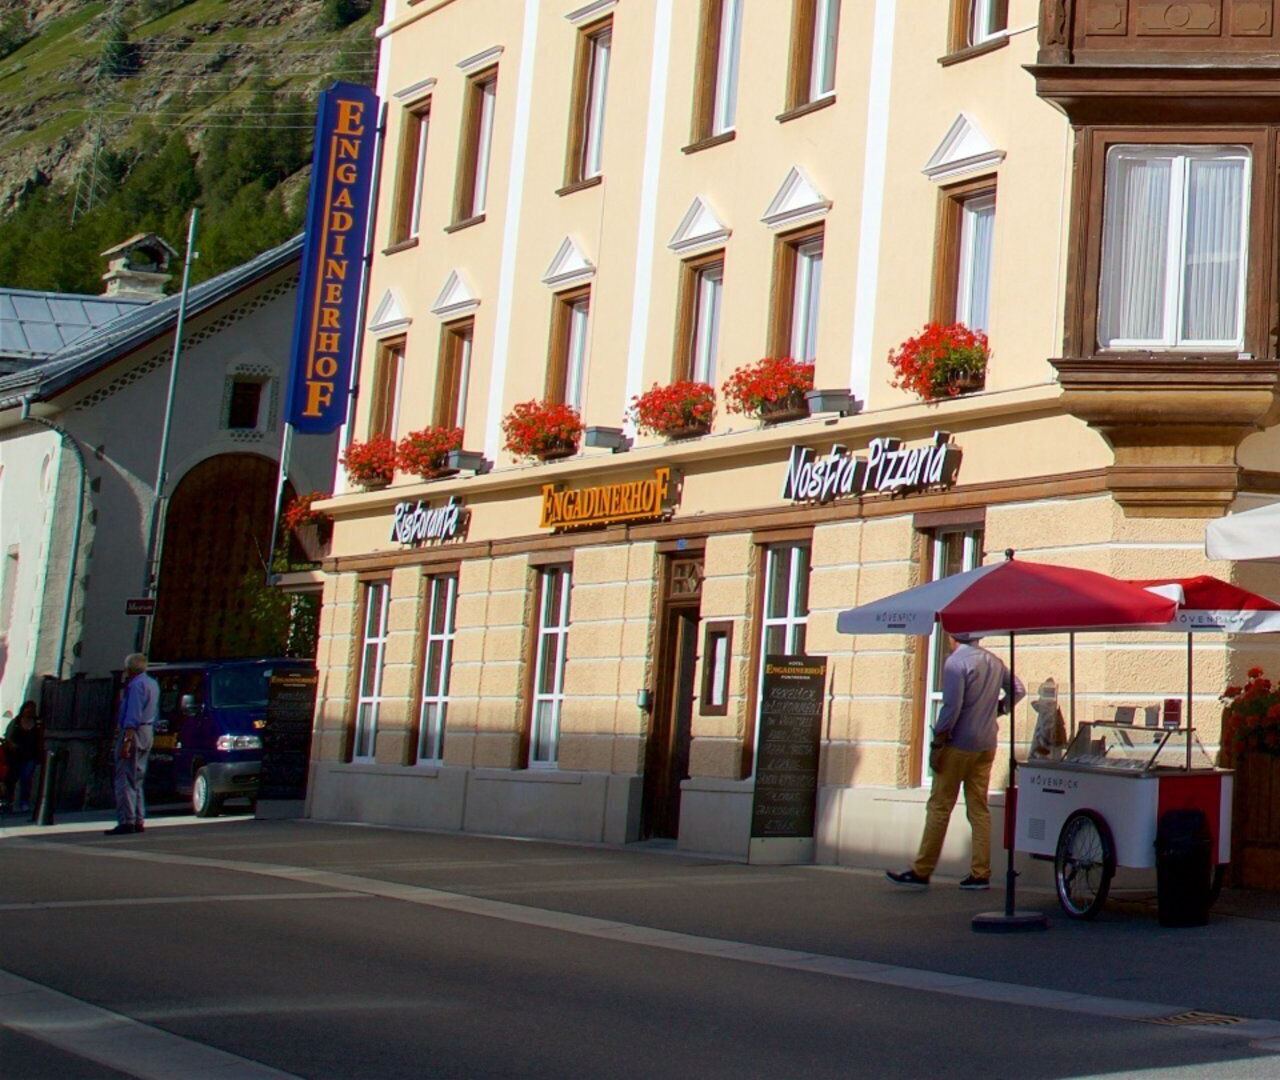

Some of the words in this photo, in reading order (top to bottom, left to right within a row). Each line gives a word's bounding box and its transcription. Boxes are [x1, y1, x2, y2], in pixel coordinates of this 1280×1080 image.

[302, 99, 365, 418] ENGADINERHOF
[539, 467, 670, 528] ENGADINERHOF
[781, 443, 860, 501] Nostra
[862, 429, 949, 492] Pizzeria
[389, 495, 460, 543] Ristorante
